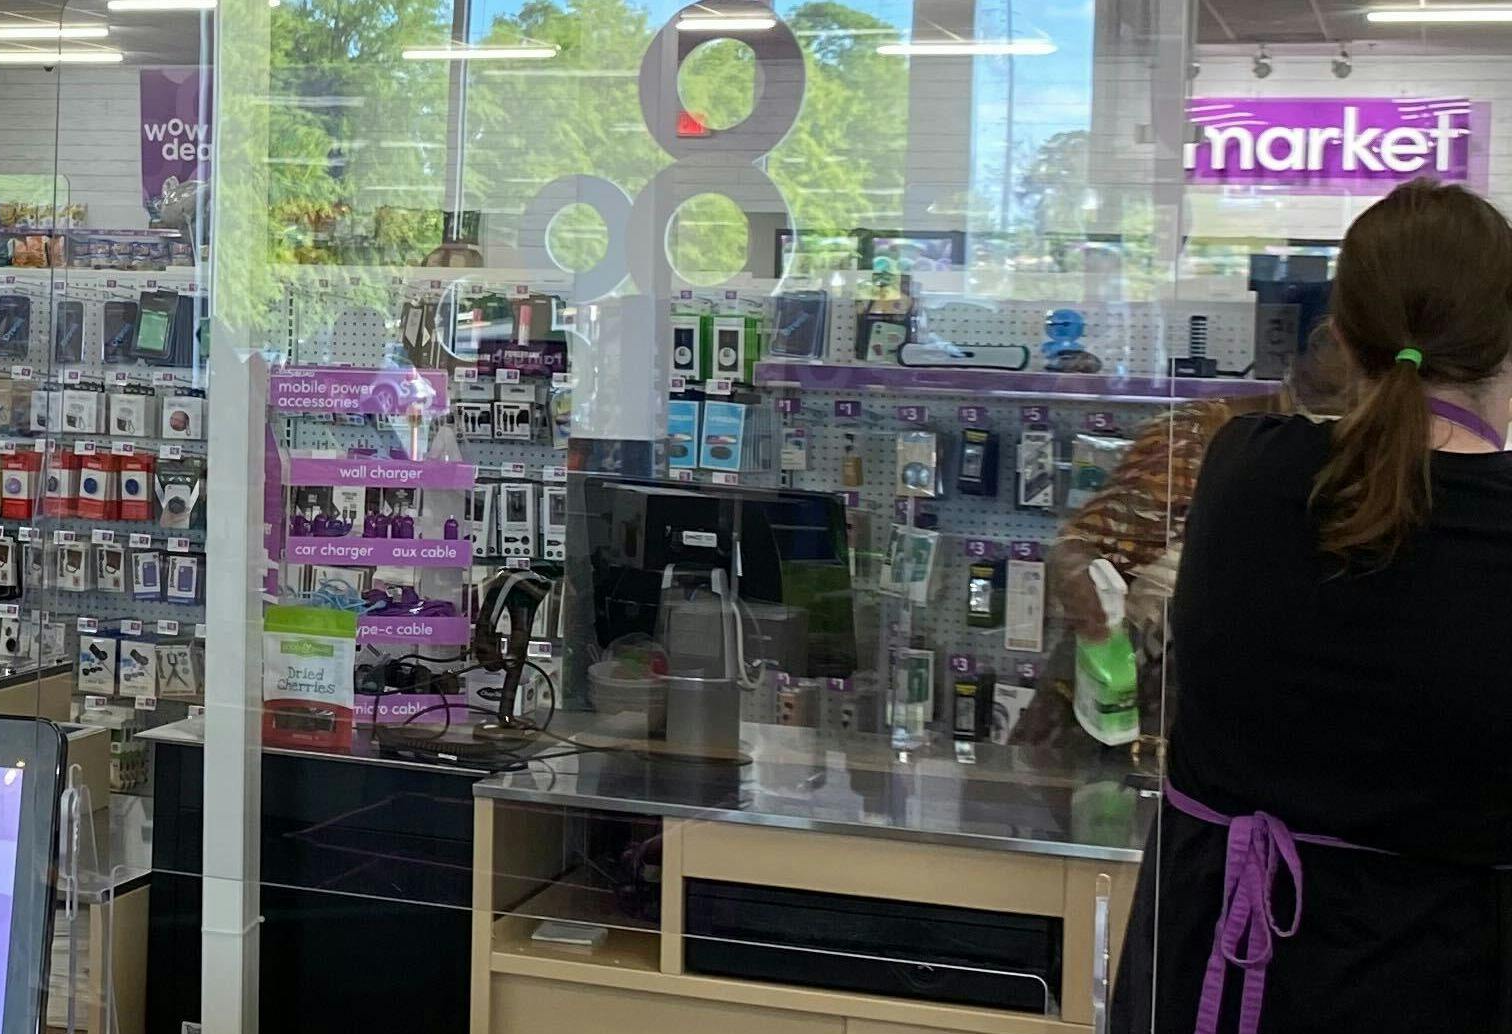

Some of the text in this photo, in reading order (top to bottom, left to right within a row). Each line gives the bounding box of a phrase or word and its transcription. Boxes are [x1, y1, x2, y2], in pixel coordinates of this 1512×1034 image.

[144, 118, 208, 141] wow
[1183, 106, 1463, 172] market
[161, 138, 213, 161] dea
[278, 379, 327, 394] mobile
[331, 383, 375, 396] power
[278, 396, 359, 409] accessories
[340, 464, 423, 482] wall charger
[295, 543, 457, 560] car charger aux cable
[355, 623, 433, 639] ype-c cable
[288, 667, 324, 681] Dried
[277, 679, 336, 694] Cherries
[353, 703, 388, 715] mico
